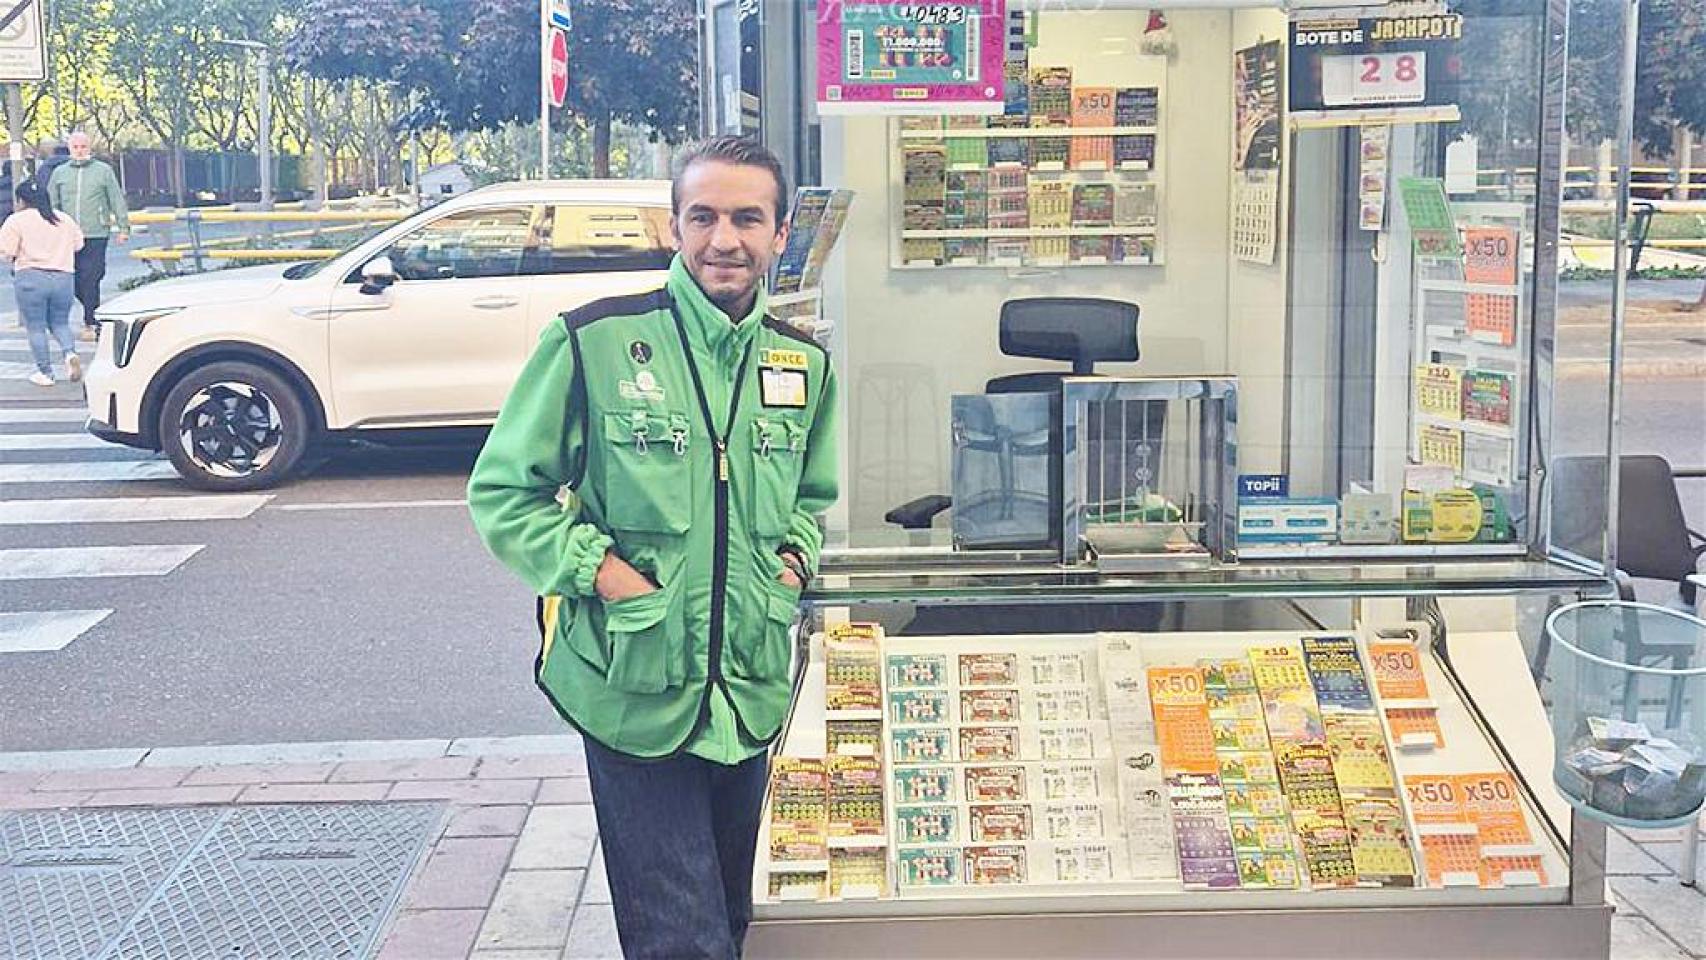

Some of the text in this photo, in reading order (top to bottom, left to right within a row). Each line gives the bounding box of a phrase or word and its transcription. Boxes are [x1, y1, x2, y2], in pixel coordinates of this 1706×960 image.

[1296, 31, 1338, 46] BOTE
[1341, 30, 1364, 43] DE
[1078, 93, 1111, 109] x50
[1470, 238, 1509, 259] x50
[772, 353, 805, 366] ONCE
[1372, 652, 1414, 671] x50
[1155, 674, 1198, 694] x50
[1410, 782, 1454, 803] x50
[1465, 780, 1510, 802] x50
